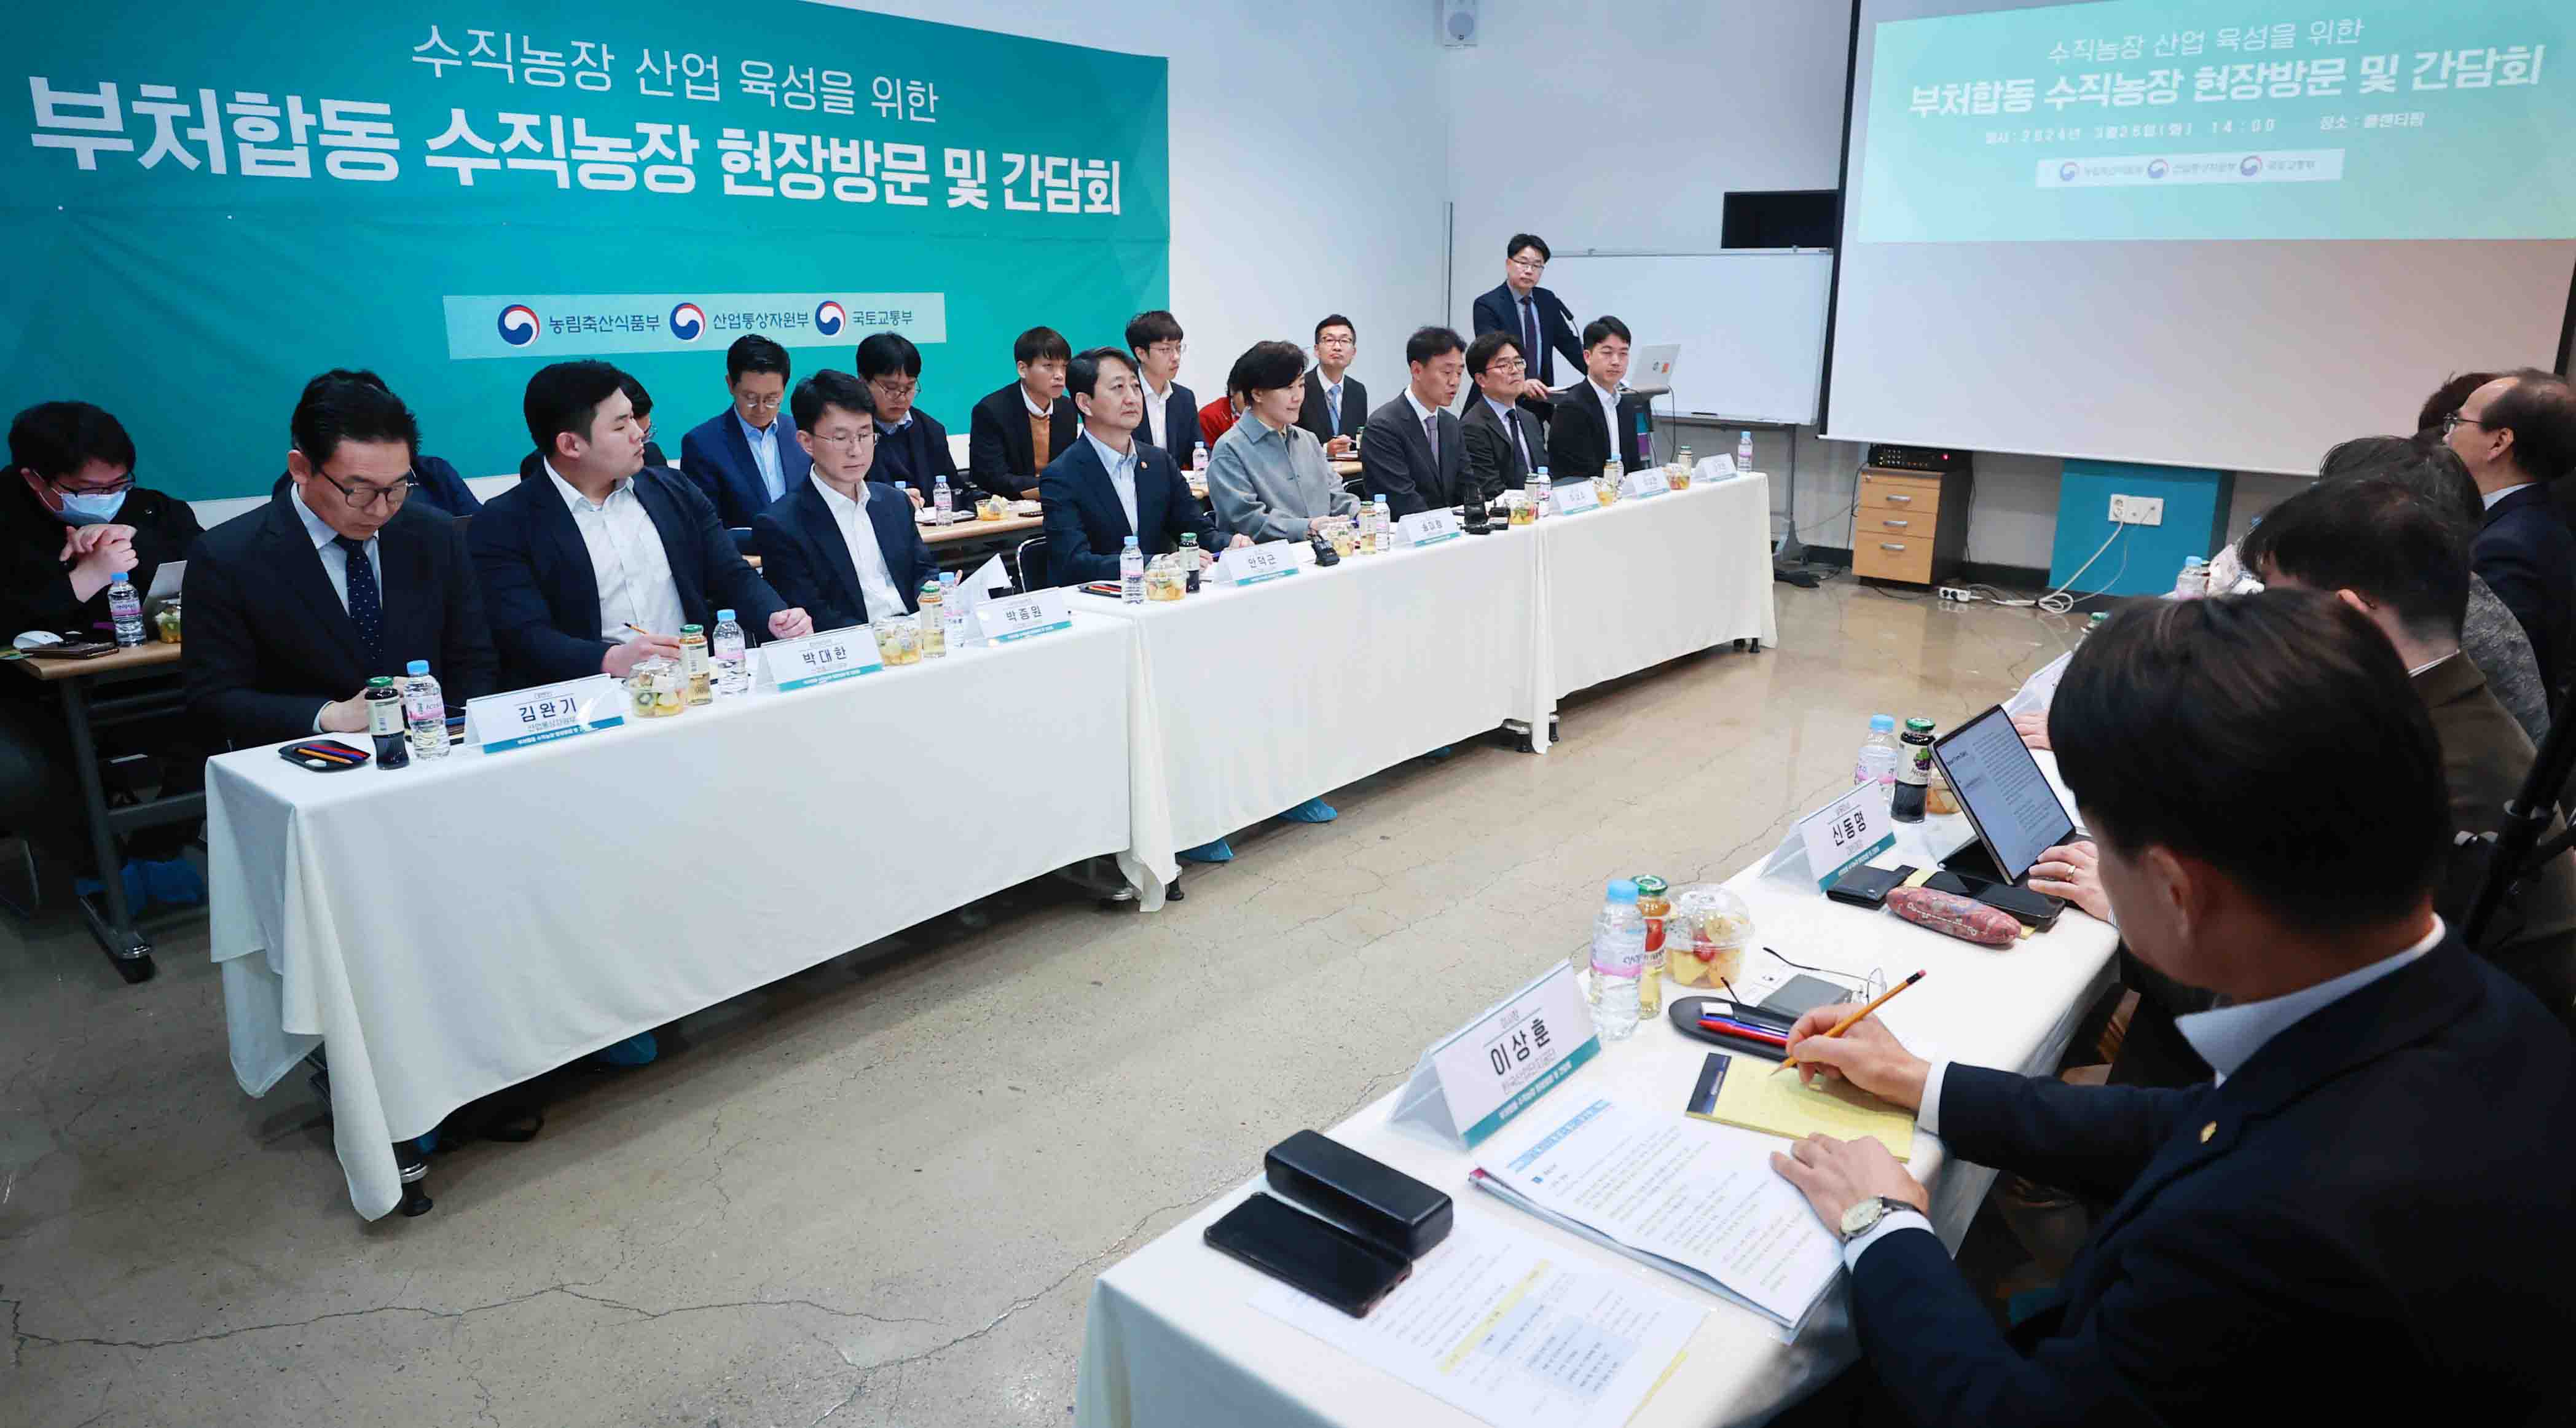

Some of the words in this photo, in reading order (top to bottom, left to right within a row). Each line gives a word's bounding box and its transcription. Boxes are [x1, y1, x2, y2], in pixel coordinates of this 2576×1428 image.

[2047, 34, 2145, 65] 수직농장
[2153, 29, 2205, 58] 산업
[2216, 23, 2296, 52] 육성을
[2307, 18, 2365, 46] 위한
[412, 25, 615, 92] 수직농장
[635, 49, 720, 102] 산업
[739, 60, 855, 115] 육성을
[871, 76, 940, 123] 위한
[1907, 78, 2036, 119] 부처합동
[2044, 68, 2185, 111] 수직농장
[2193, 58, 2346, 103] 현장방문
[2359, 53, 2400, 94] 및
[2411, 45, 2545, 91] 간담회
[29, 76, 400, 181] 부처합동
[425, 108, 700, 194] 수직농장
[717, 127, 930, 206] 현장방문
[944, 147, 989, 210] 및
[1002, 153, 1121, 216] 간담회
[548, 314, 660, 335] 농림축산식품부
[713, 312, 809, 330] 산업통상자원부
[852, 310, 913, 326] 국토교통부
[1006, 605, 1042, 622] 박종원
[803, 646, 846, 665] 박대한
[519, 697, 577, 723] 김완기
[1832, 811, 1866, 847] 신동명
[1490, 1018, 1550, 1076] 이상훈
